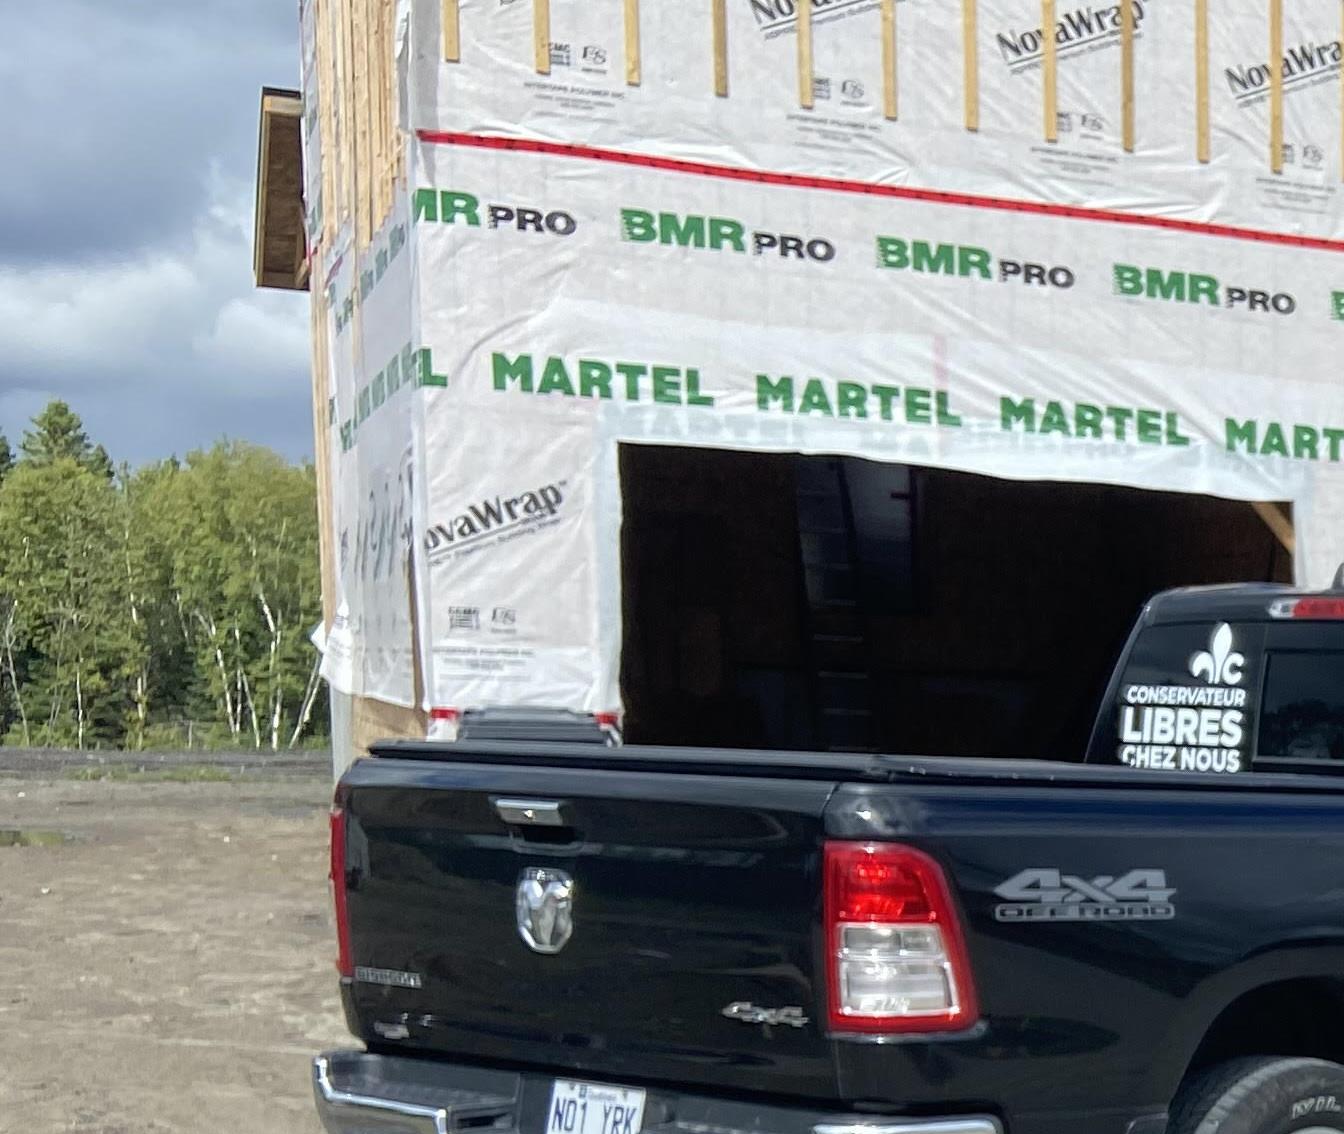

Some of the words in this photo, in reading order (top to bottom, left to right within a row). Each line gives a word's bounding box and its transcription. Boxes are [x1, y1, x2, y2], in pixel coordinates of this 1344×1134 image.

[488, 204, 576, 236] PRO
[619, 208, 746, 253] BMR
[752, 231, 837, 263] PRO
[875, 236, 992, 281] BMR
[999, 260, 1076, 290] PRO
[1112, 262, 1221, 306] BMR
[1225, 286, 1297, 316] PRO
[491, 352, 715, 407] MARTEL
[755, 373, 963, 428] MARTEL
[1000, 396, 1190, 447] MARTEL
[1126, 685, 1247, 707] CONSERVATEUR
[1121, 705, 1244, 748] LIBRES
[1121, 744, 1177, 769] CHEZ
[1179, 747, 1241, 773] NOUS
